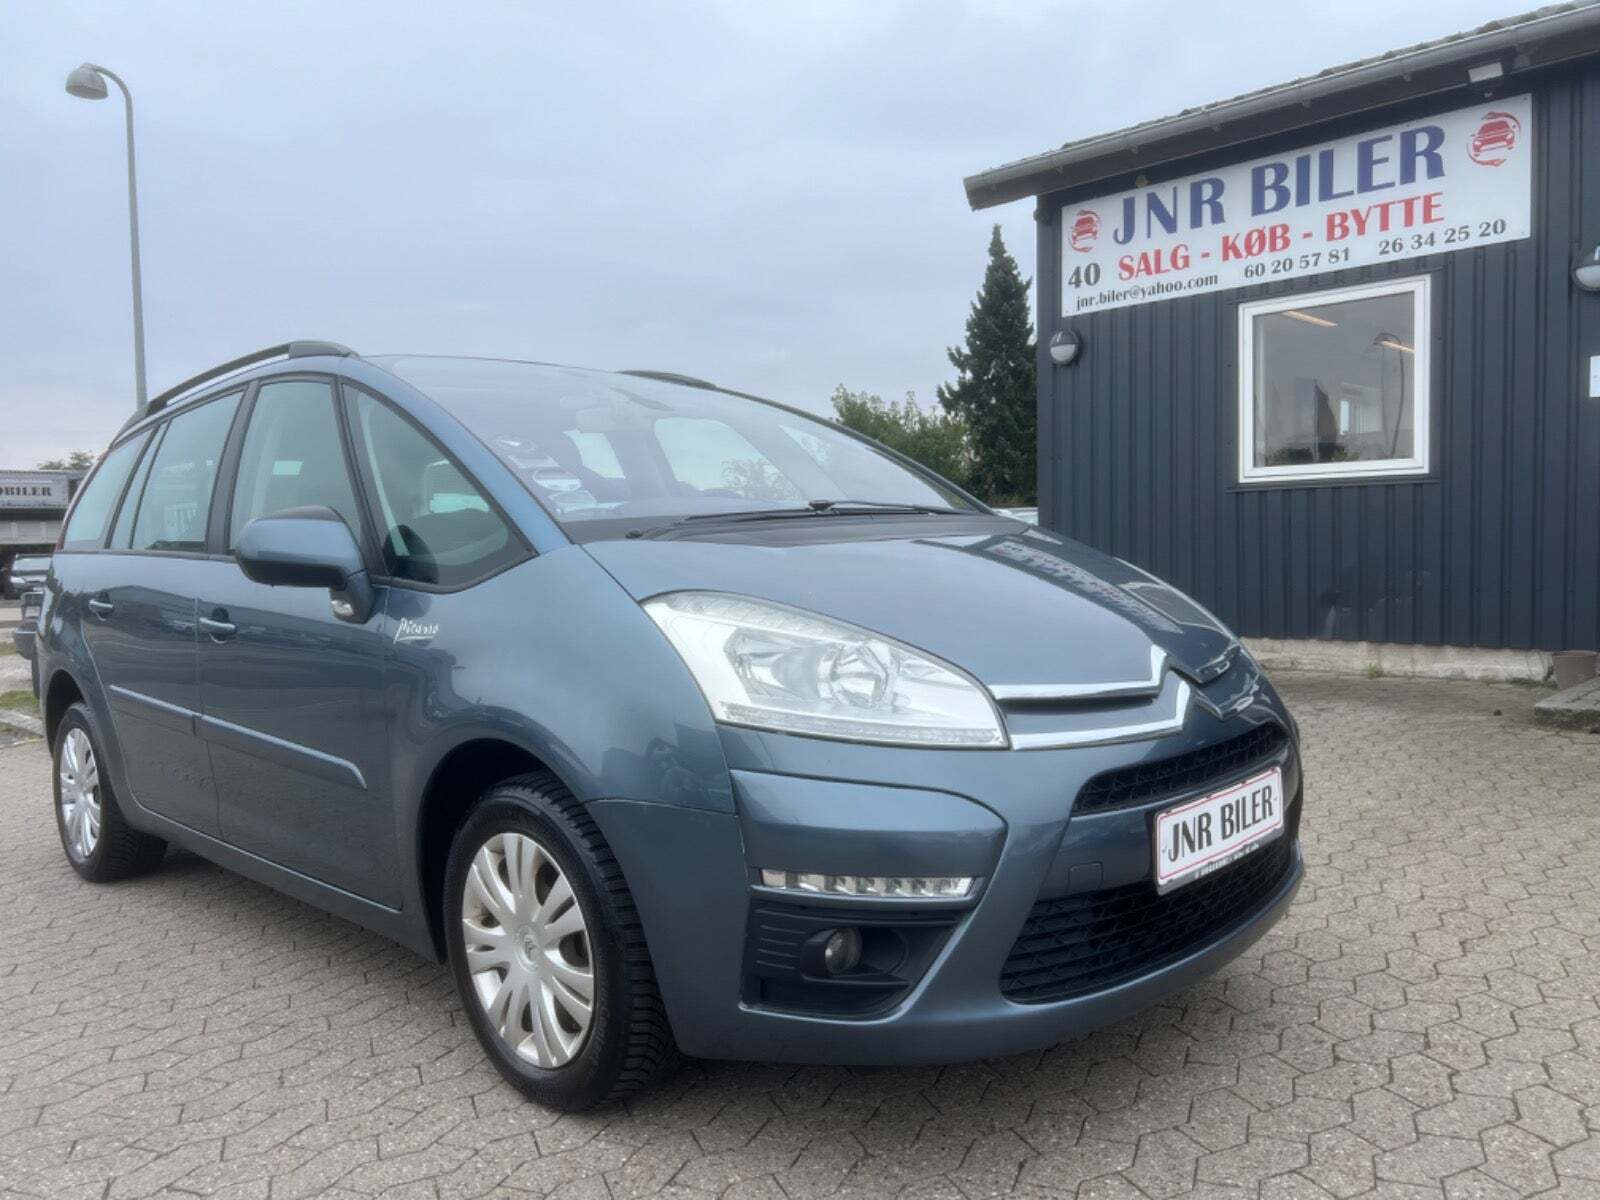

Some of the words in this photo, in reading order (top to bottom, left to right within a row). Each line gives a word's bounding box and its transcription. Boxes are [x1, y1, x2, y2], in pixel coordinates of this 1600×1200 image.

[1113, 177, 1225, 245] JNR
[1251, 125, 1446, 217] BILER
[1068, 262, 1100, 289] 40
[1075, 274, 1219, 311] jnr.biler@yahoo.com
[1244, 263, 1266, 279] 60
[1271, 257, 1293, 275] 20
[1299, 252, 1322, 269] 57
[1328, 247, 1350, 264] 81
[1378, 238, 1404, 255] 26
[1410, 231, 1436, 250] 34
[1444, 225, 1471, 244] 25
[1479, 218, 1507, 238] 20
[1118, 244, 1190, 281] SALG
[1221, 223, 1292, 263] KØB
[1326, 192, 1445, 242] BYTTE
[1168, 812, 1213, 862] JNR
[1220, 785, 1274, 840] BILER
